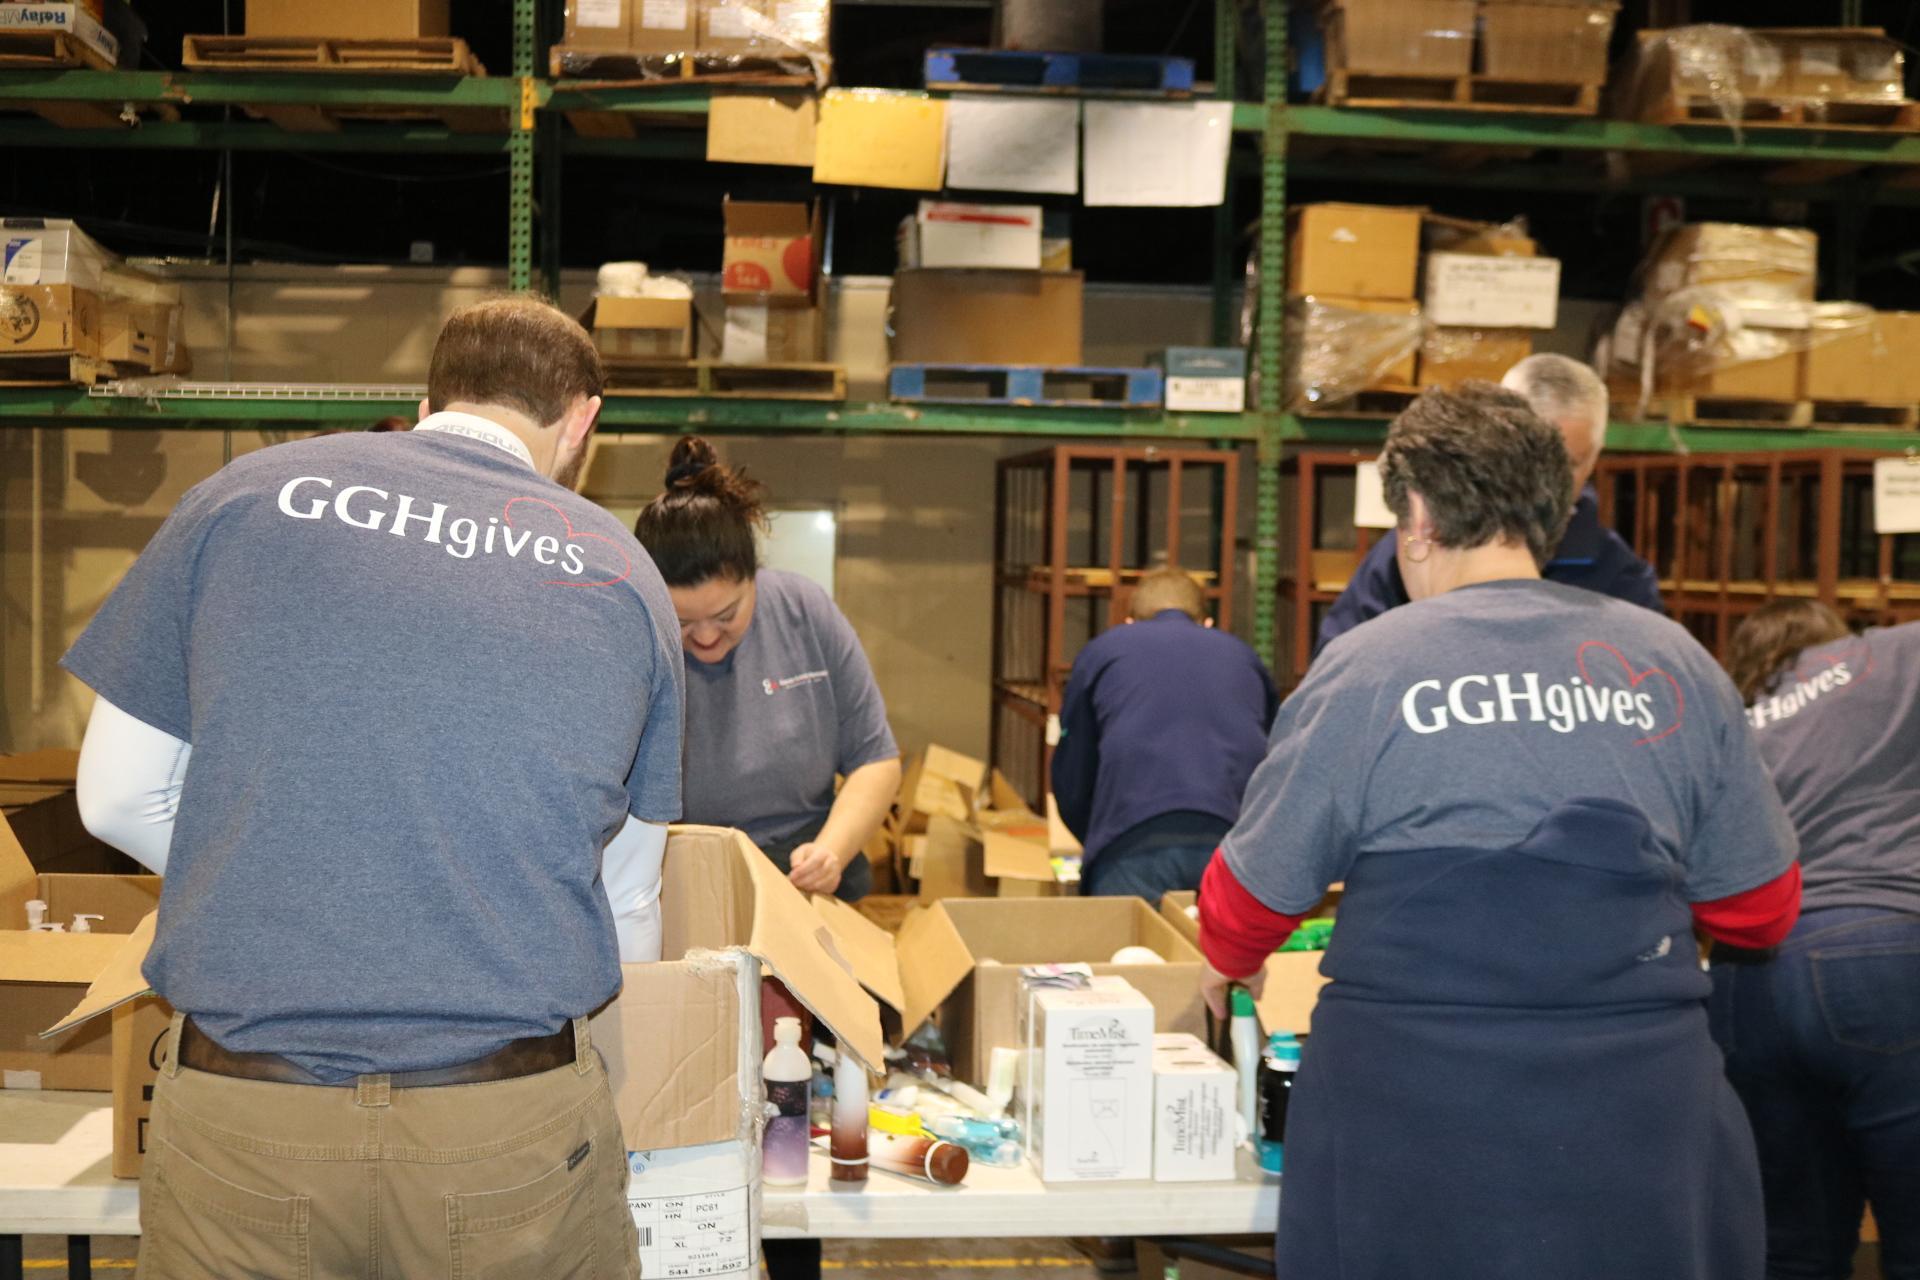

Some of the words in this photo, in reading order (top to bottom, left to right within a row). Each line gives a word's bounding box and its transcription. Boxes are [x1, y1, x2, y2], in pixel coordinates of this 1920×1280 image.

[277, 476, 585, 576] GGHgives
[1401, 672, 1656, 734] GGHgives
[1744, 661, 1853, 729] Hgives
[1069, 1018, 1126, 1042] TimeMist
[1166, 1097, 1188, 1153] TimeMist
